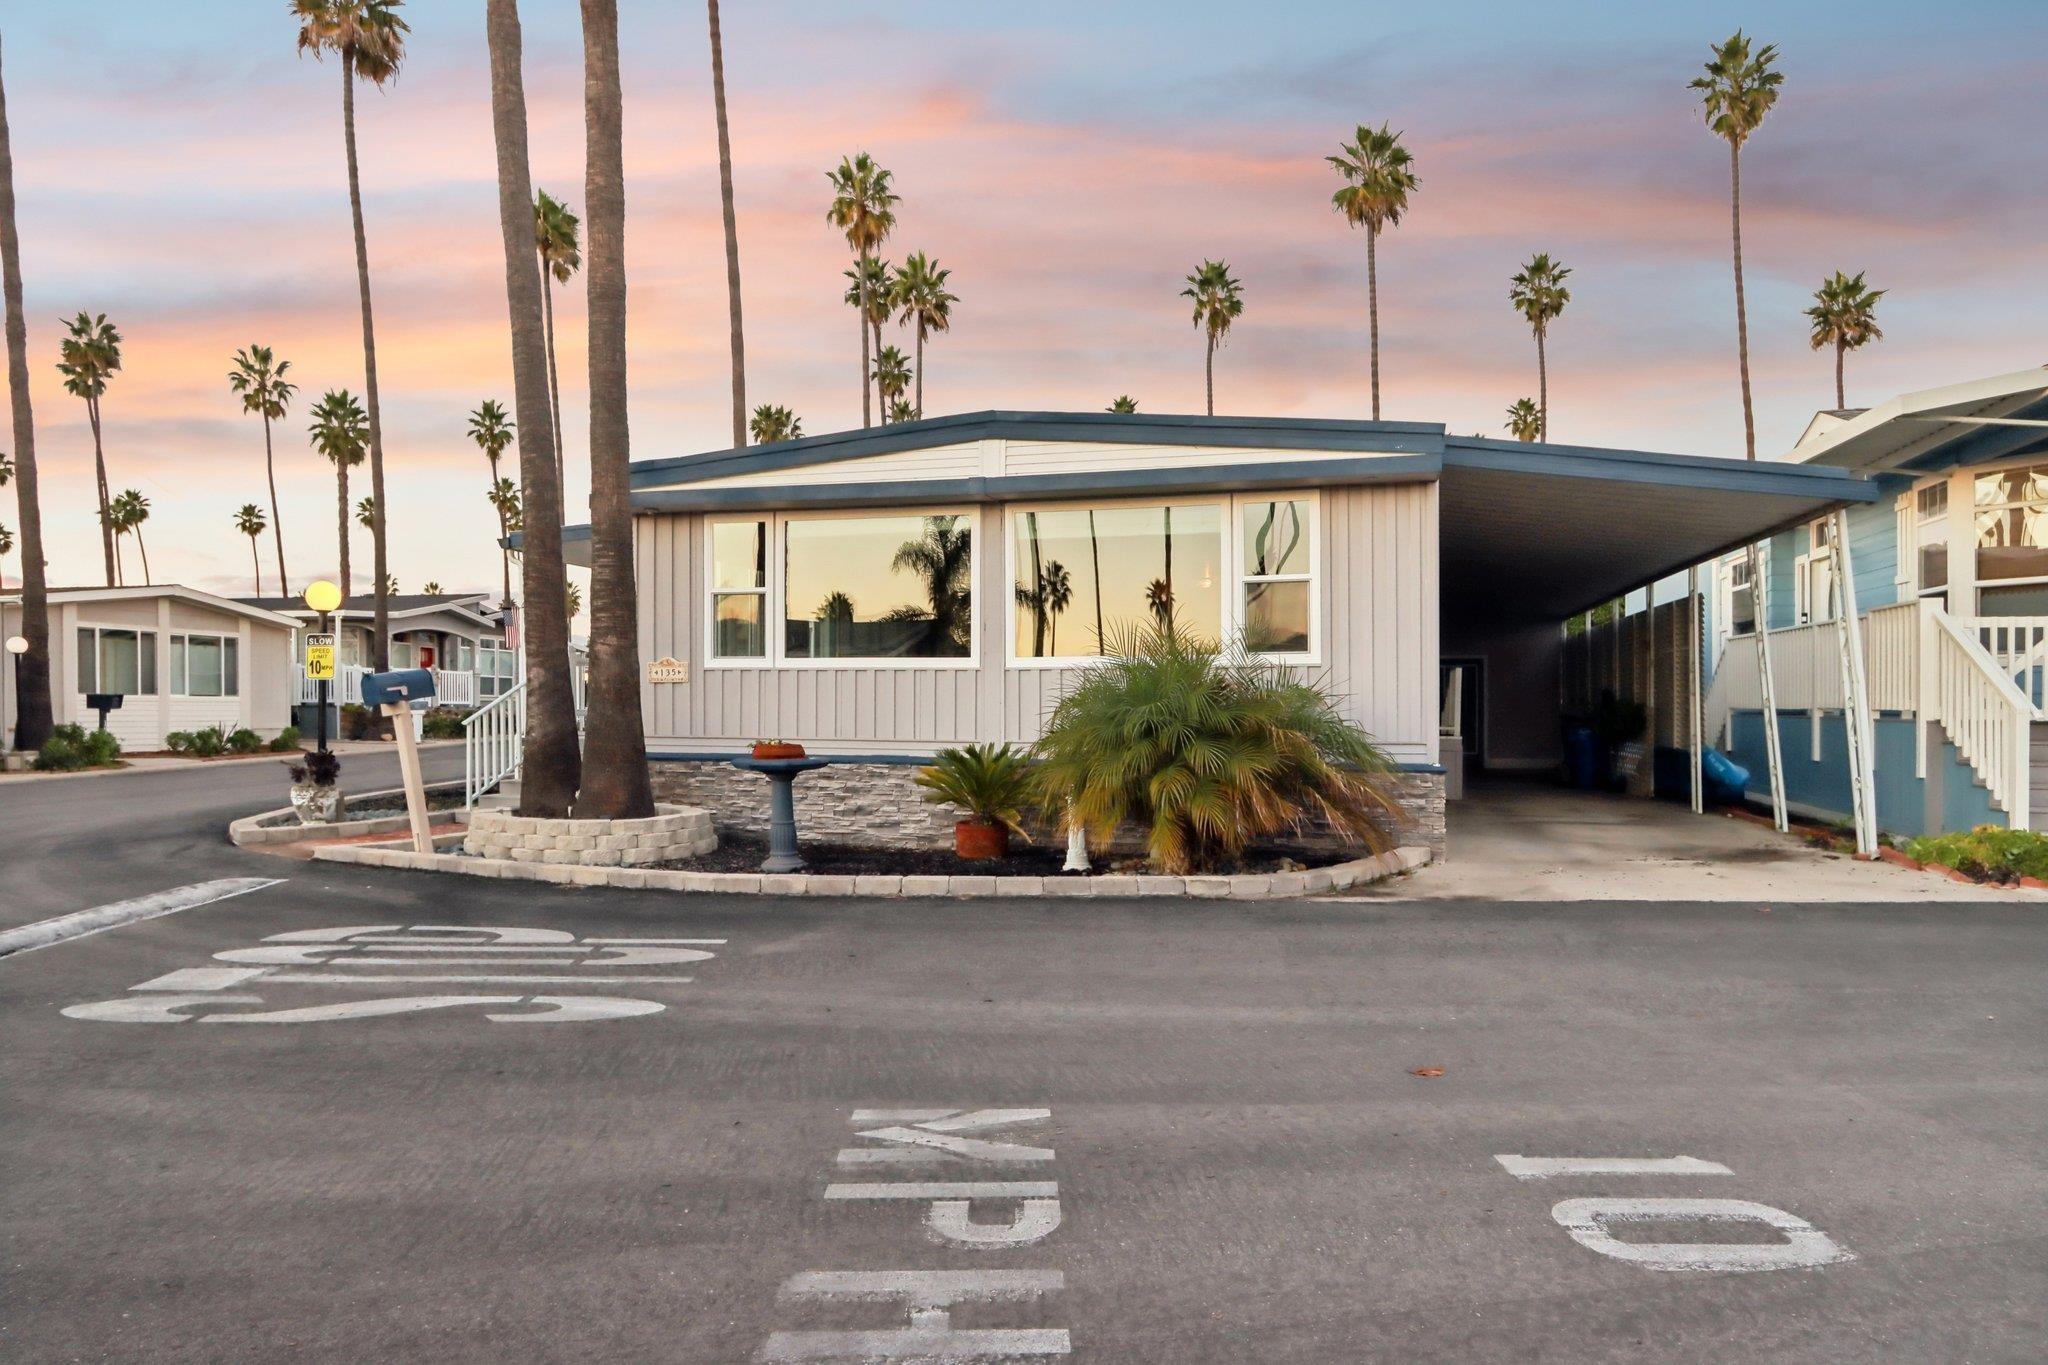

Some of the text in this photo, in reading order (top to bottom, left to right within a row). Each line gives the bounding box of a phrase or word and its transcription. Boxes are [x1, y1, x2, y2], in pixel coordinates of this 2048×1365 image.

[309, 660, 321, 674] 10
[660, 668, 676, 677] 135
[60, 925, 728, 1023] STOP
[758, 1108, 1071, 1362] MPH
[1493, 1154, 1856, 1272] 10
